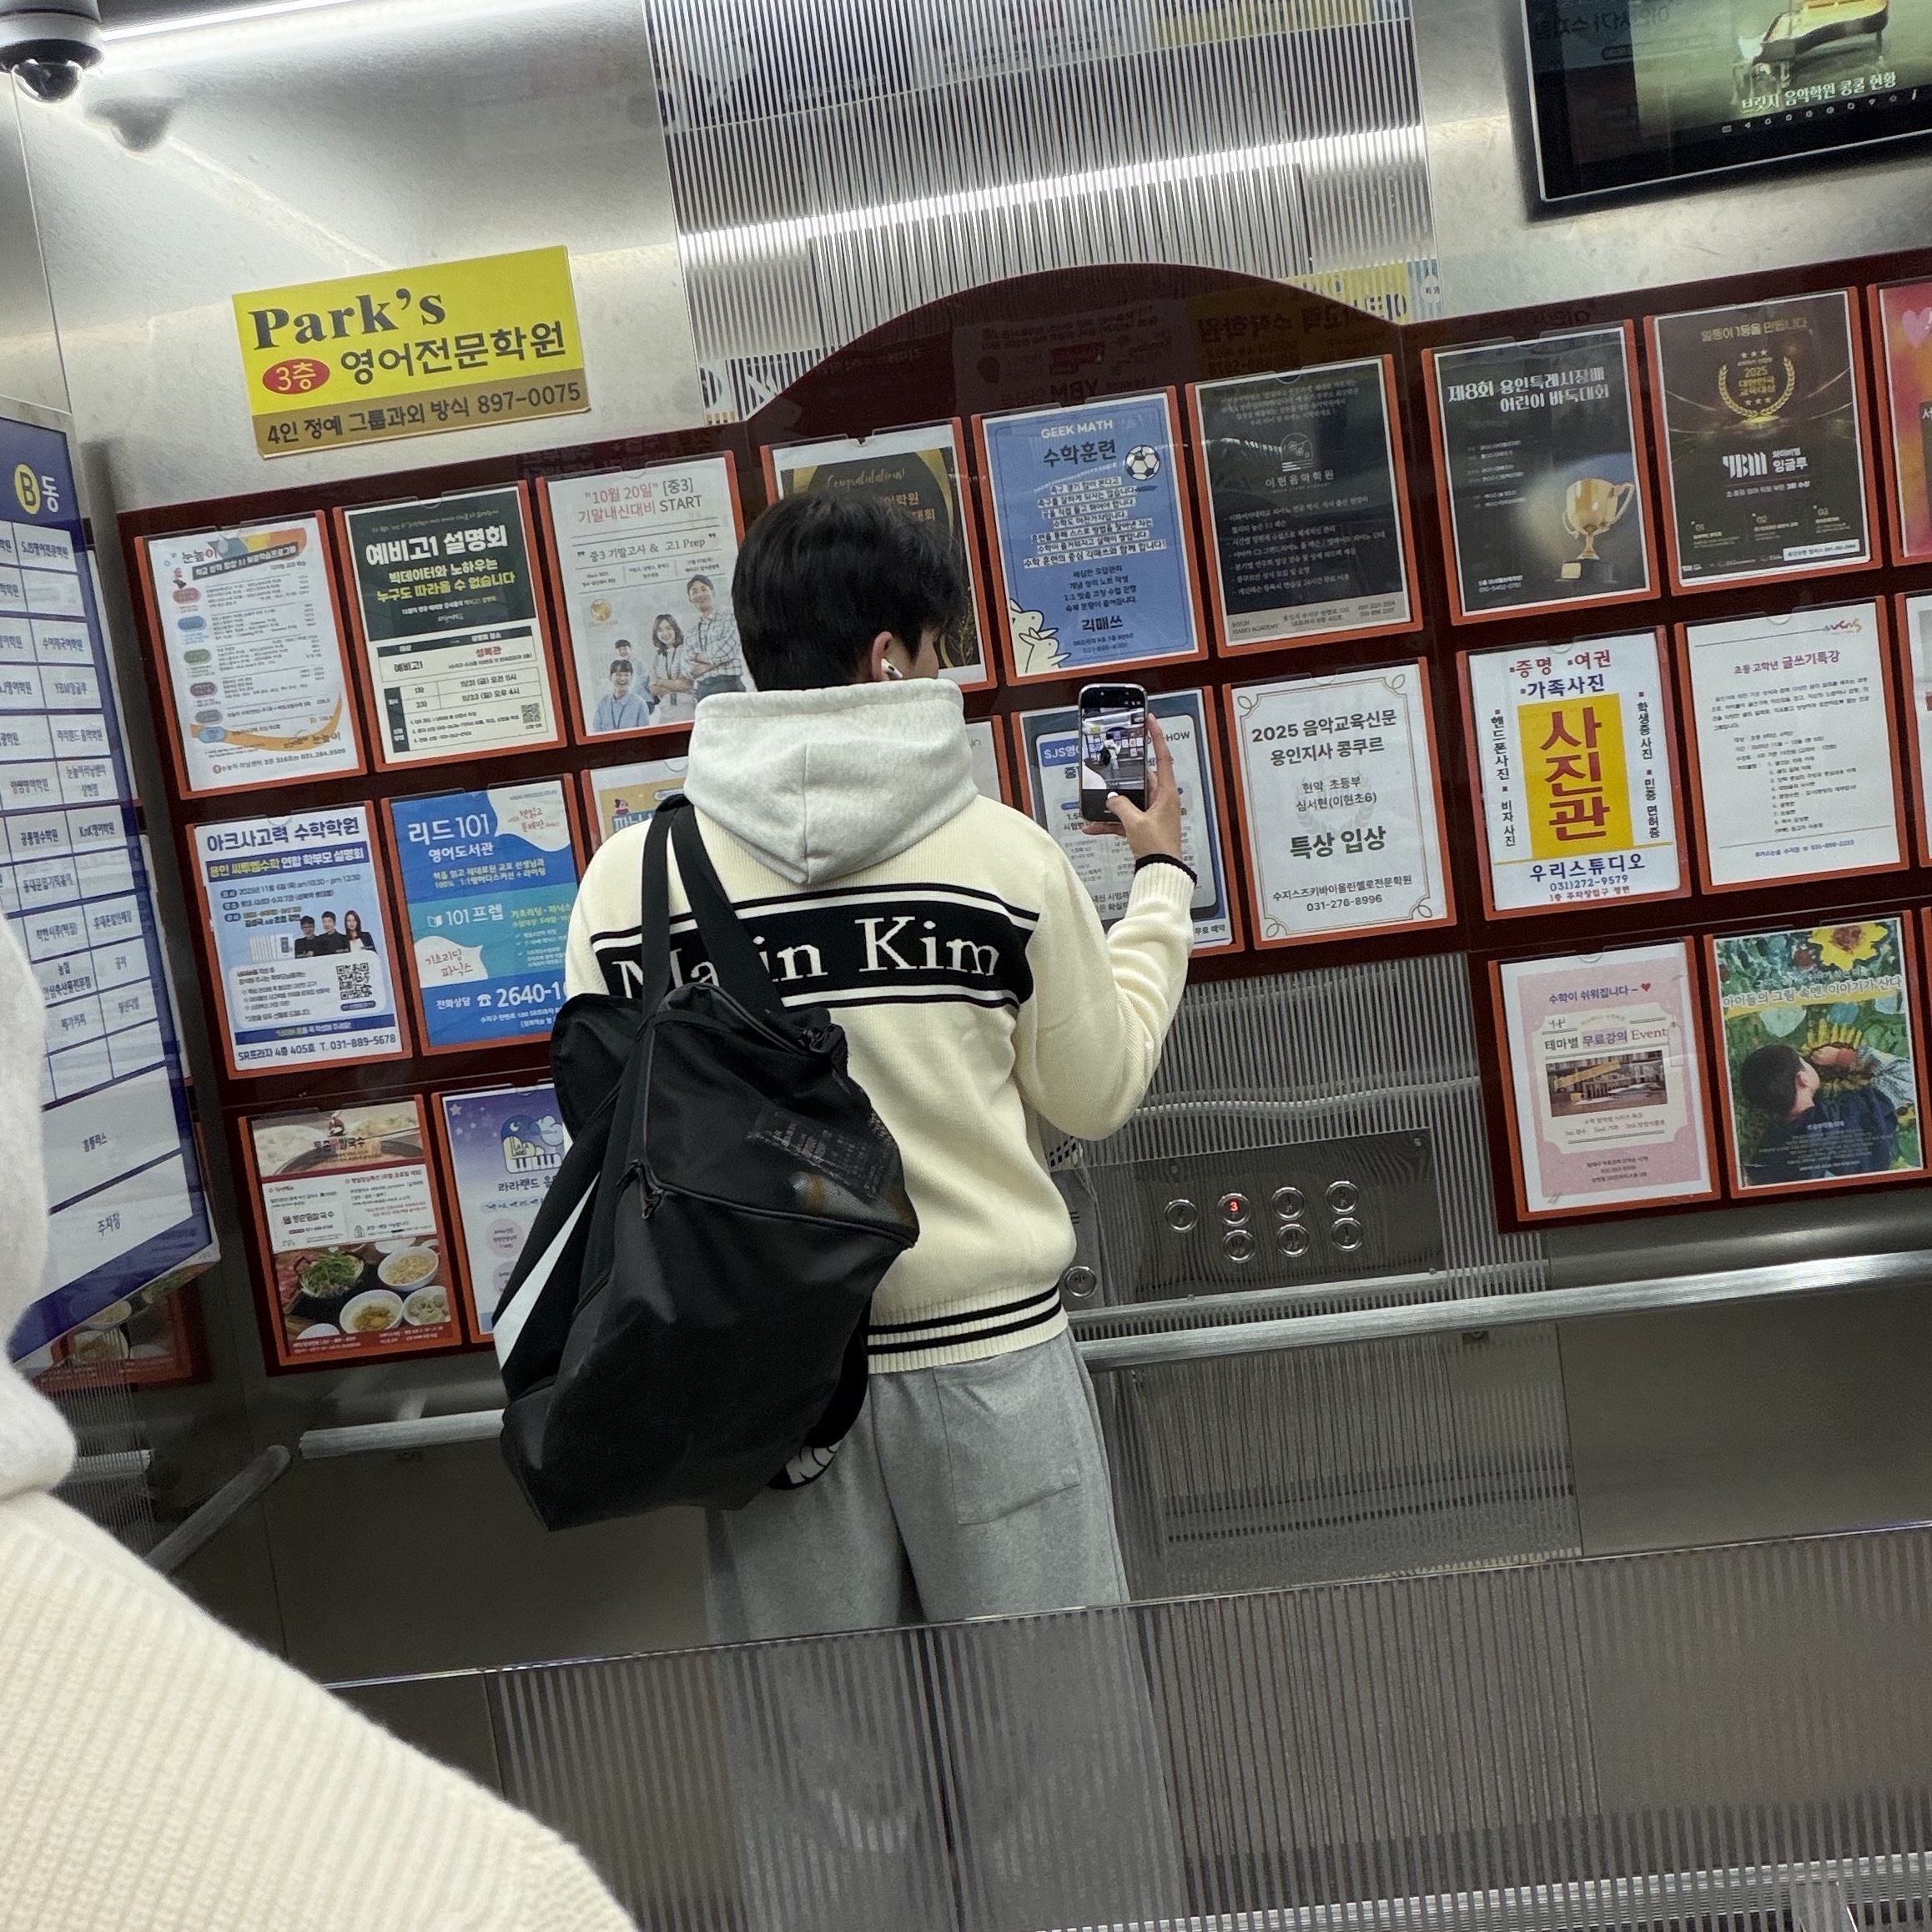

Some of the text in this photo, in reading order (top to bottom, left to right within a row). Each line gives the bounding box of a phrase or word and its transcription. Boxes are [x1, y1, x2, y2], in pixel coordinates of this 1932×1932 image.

[1784, 83, 1835, 107] 음악학원
[1869, 72, 1897, 90] 현황
[275, 320, 566, 392] 3층 영어전문학원
[1743, 365, 1768, 376] 2025
[1446, 380, 1494, 403] 제8회
[1500, 383, 1610, 413] 어린이 바둑대회
[268, 382, 581, 445] 4인 정예 그룹과외 방식 897-0075
[1041, 420, 1113, 440] GEEK MATH
[1043, 439, 1117, 467] 수학훈련
[1773, 455, 1809, 474] 잉글루
[662, 477, 694, 496] [중3]
[578, 494, 702, 524] 기말내신대비 START
[365, 525, 508, 566] 예비고1 설명회
[589, 550, 606, 563] 중3
[608, 544, 647, 559] 기말고사
[666, 540, 681, 551] 고1
[682, 537, 706, 550] Prep
[388, 558, 499, 585] 빅데이터와 노하우는
[377, 571, 516, 603] 누구도 수 없습니다
[1574, 649, 1612, 671] 여권
[1733, 649, 1840, 675] 초등 고학년 글쓰기특강
[1527, 673, 1606, 700] 가족사진
[1251, 709, 1397, 742] 2025 음악교육신문
[1270, 737, 1386, 767] 용인지사 콩쿠르
[1329, 776, 1361, 790] 초등부
[1540, 706, 1611, 842] 사진관
[207, 817, 360, 853] 아크사고력 수학학원
[1290, 826, 1386, 860] 특상 입상
[303, 852, 332, 866] 학부모
[333, 848, 365, 863] 설명회
[428, 842, 495, 863] 영어도서관
[1529, 853, 1645, 882] 우리스튜디오
[1549, 875, 1628, 892] 031)272-9579
[853, 916, 1000, 977] Kim
[440, 963, 475, 979] 파닉스
[436, 995, 471, 1010] 전화상담
[1548, 990, 1578, 1004] 수학이
[1723, 990, 1769, 1009] 아이들의
[1828, 979, 1876, 994] 이야기가
[1878, 975, 1903, 990] 산다
[289, 1043, 316, 1055] 405호
[330, 1034, 397, 1051] 031-889-5678
[1544, 1027, 1668, 1052] 테마별 무료강의 Event
[497, 1178, 540, 1192] 라라랜드
[1229, 1200, 1239, 1212] 3
[98, 1212, 121, 1235] 주차장
